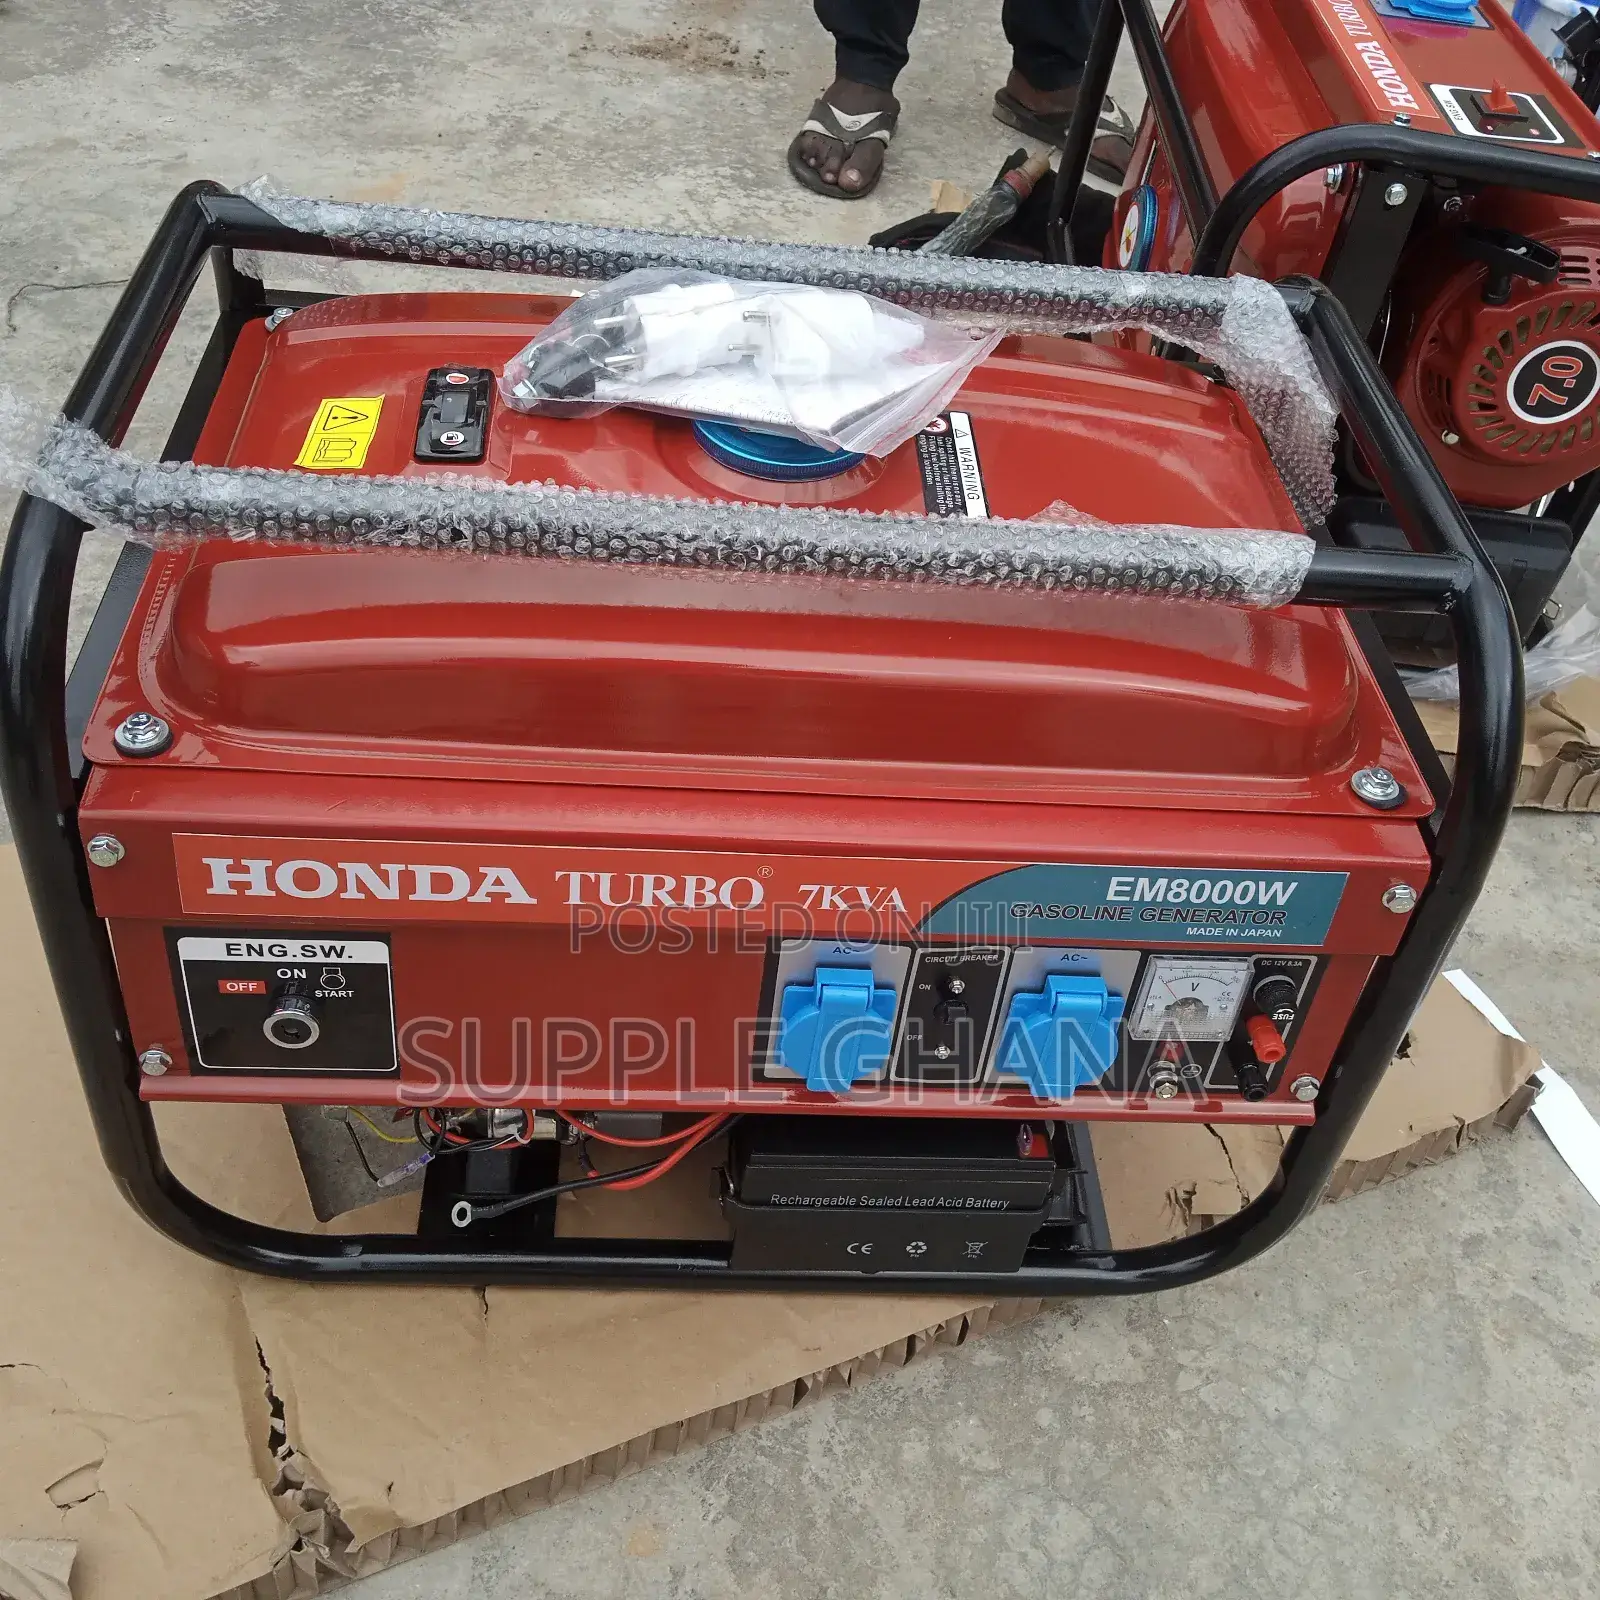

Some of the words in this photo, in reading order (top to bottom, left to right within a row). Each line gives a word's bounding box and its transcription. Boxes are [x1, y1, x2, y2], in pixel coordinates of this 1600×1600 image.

[1353, 40, 1420, 110] HONDA
[1526, 355, 1584, 406] 7.0
[945, 437, 954, 453] Check
[958, 447, 980, 500] WARNING
[202, 857, 538, 905] HONDA
[798, 884, 908, 913] 7KVA
[1106, 876, 1298, 906] EM8000W
[1010, 903, 1132, 923] GASOLINE
[1137, 906, 1287, 926] GENERATOR
[1186, 927, 1223, 937] MADE
[1225, 928, 1239, 938] IN
[1240, 928, 1282, 938] JAPAN
[225, 942, 354, 960] ENG.SW.
[924, 955, 958, 964] CIRCUIT
[959, 954, 999, 963] BREAKER
[276, 967, 307, 979] ON
[226, 981, 257, 992] OFF
[315, 990, 354, 998] START
[1191, 982, 1201, 993] V
[771, 1194, 856, 1207] Rechargeable
[859, 1195, 902, 1207] Sealed
[904, 1197, 935, 1208] Lead
[936, 1197, 963, 1209] Acid
[965, 1198, 1010, 1210] Battery
